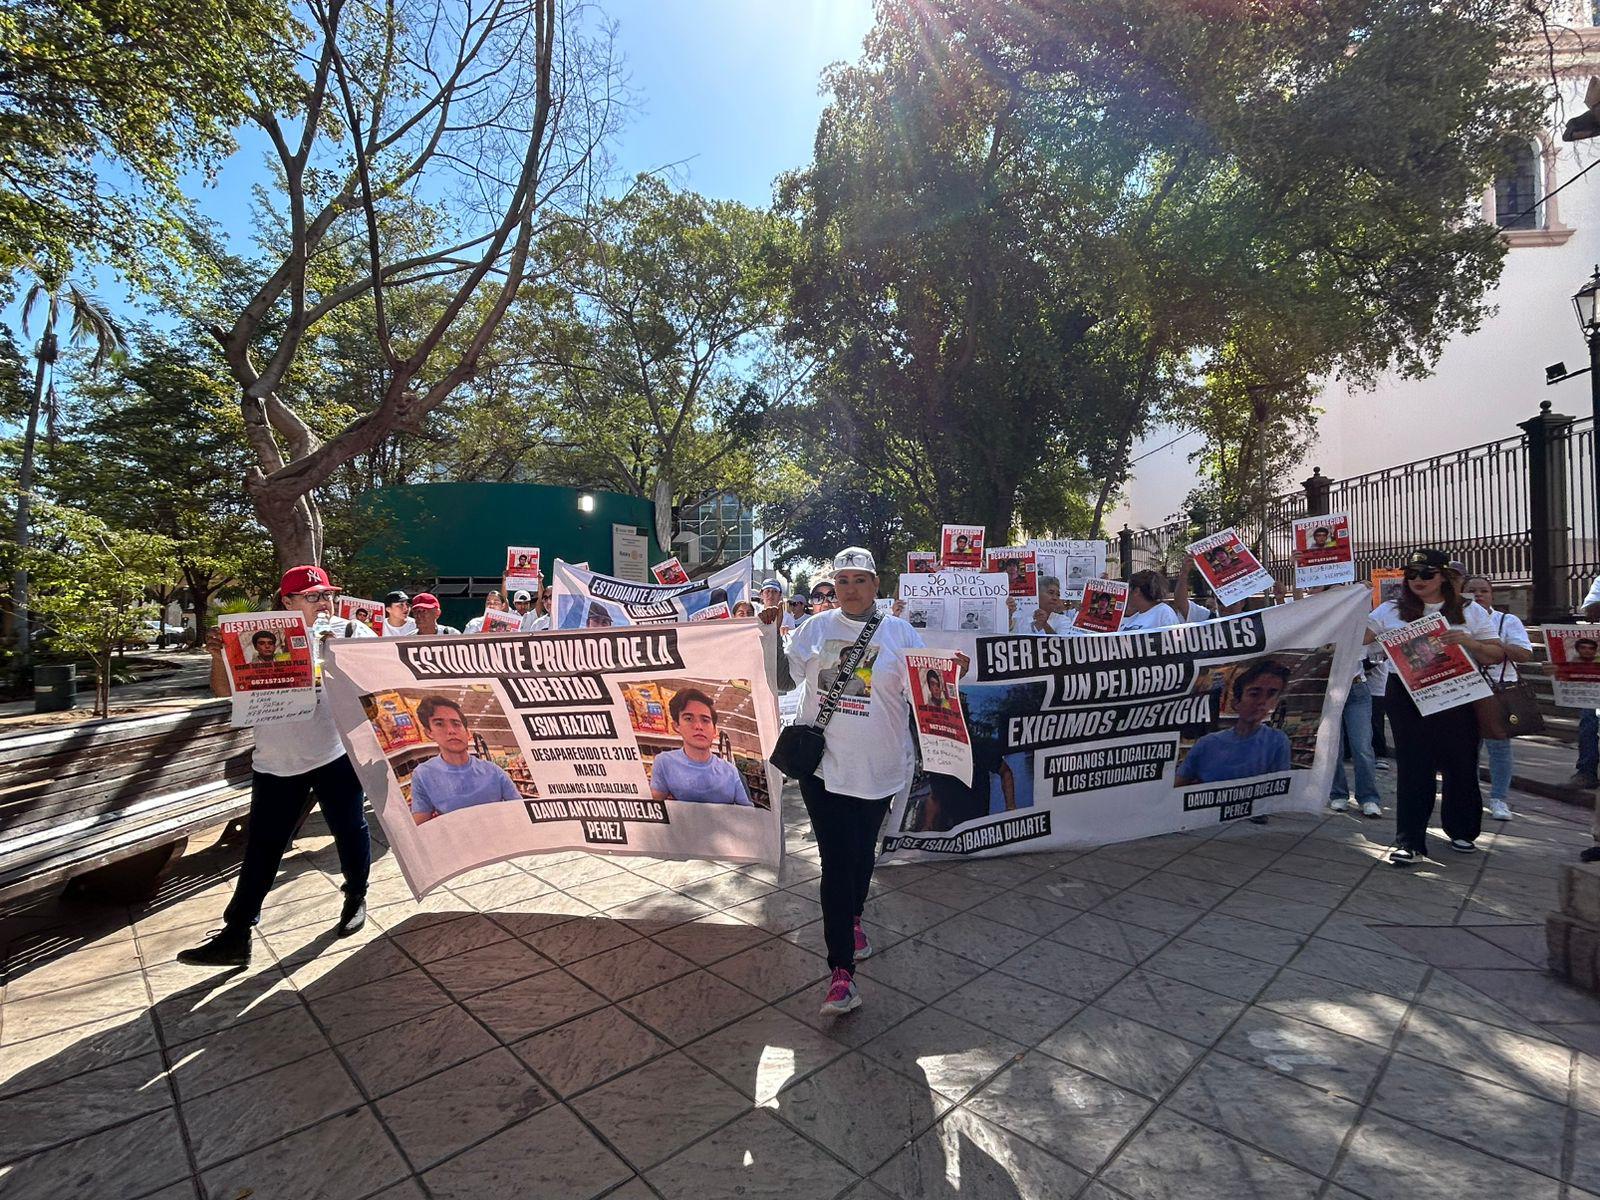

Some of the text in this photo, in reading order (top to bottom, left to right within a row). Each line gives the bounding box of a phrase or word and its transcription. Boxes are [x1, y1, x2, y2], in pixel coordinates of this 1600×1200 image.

[1297, 516, 1344, 530] DESAPARECIDO
[990, 551, 1033, 560] DESAPARECIDO
[927, 574, 946, 586] 56
[592, 579, 649, 604] ESTUDIANTE
[904, 584, 1008, 598] DESAPARECIDOS
[627, 600, 672, 617] LIBERTAD
[224, 618, 299, 634] DESAPARECIDO
[860, 623, 876, 646] LOLA
[1386, 620, 1441, 647] DESAPARECIDO
[1551, 630, 1600, 638] DESAPARE
[1036, 634, 1157, 670] ESTUDIANTE
[1162, 626, 1228, 656] AHORA
[1231, 617, 1258, 648] ES
[408, 636, 674, 674] ESTUDIANTE PRIVADO DE LA
[908, 656, 953, 672] DESAPARECIDO
[508, 676, 603, 704] LIBERTAD
[1062, 663, 1184, 702] UN PELIGRO!
[560, 714, 611, 736] RAZON!
[1008, 710, 1116, 747] EXIGIMOS
[1116, 694, 1211, 732] JUSTICIA
[531, 747, 638, 761] DESAPARECIDO EL 31 DE
[1048, 744, 1172, 774] AYUDANOS A LOCALIZAR
[574, 764, 608, 777] MARZO
[1058, 764, 1158, 792] A LOS ESTUDIANTES
[548, 783, 639, 794] AYUDANOS A LOCALIZARLO
[1188, 780, 1287, 808] DAVID ANTONIO RUELAS
[530, 800, 664, 820] DAVID ANTONIO RUELAS
[1224, 802, 1250, 818] PEREZ
[586, 820, 623, 840] PEREZ
[886, 814, 1047, 853] JOSE ISAIAS IBARRA DUARTE
